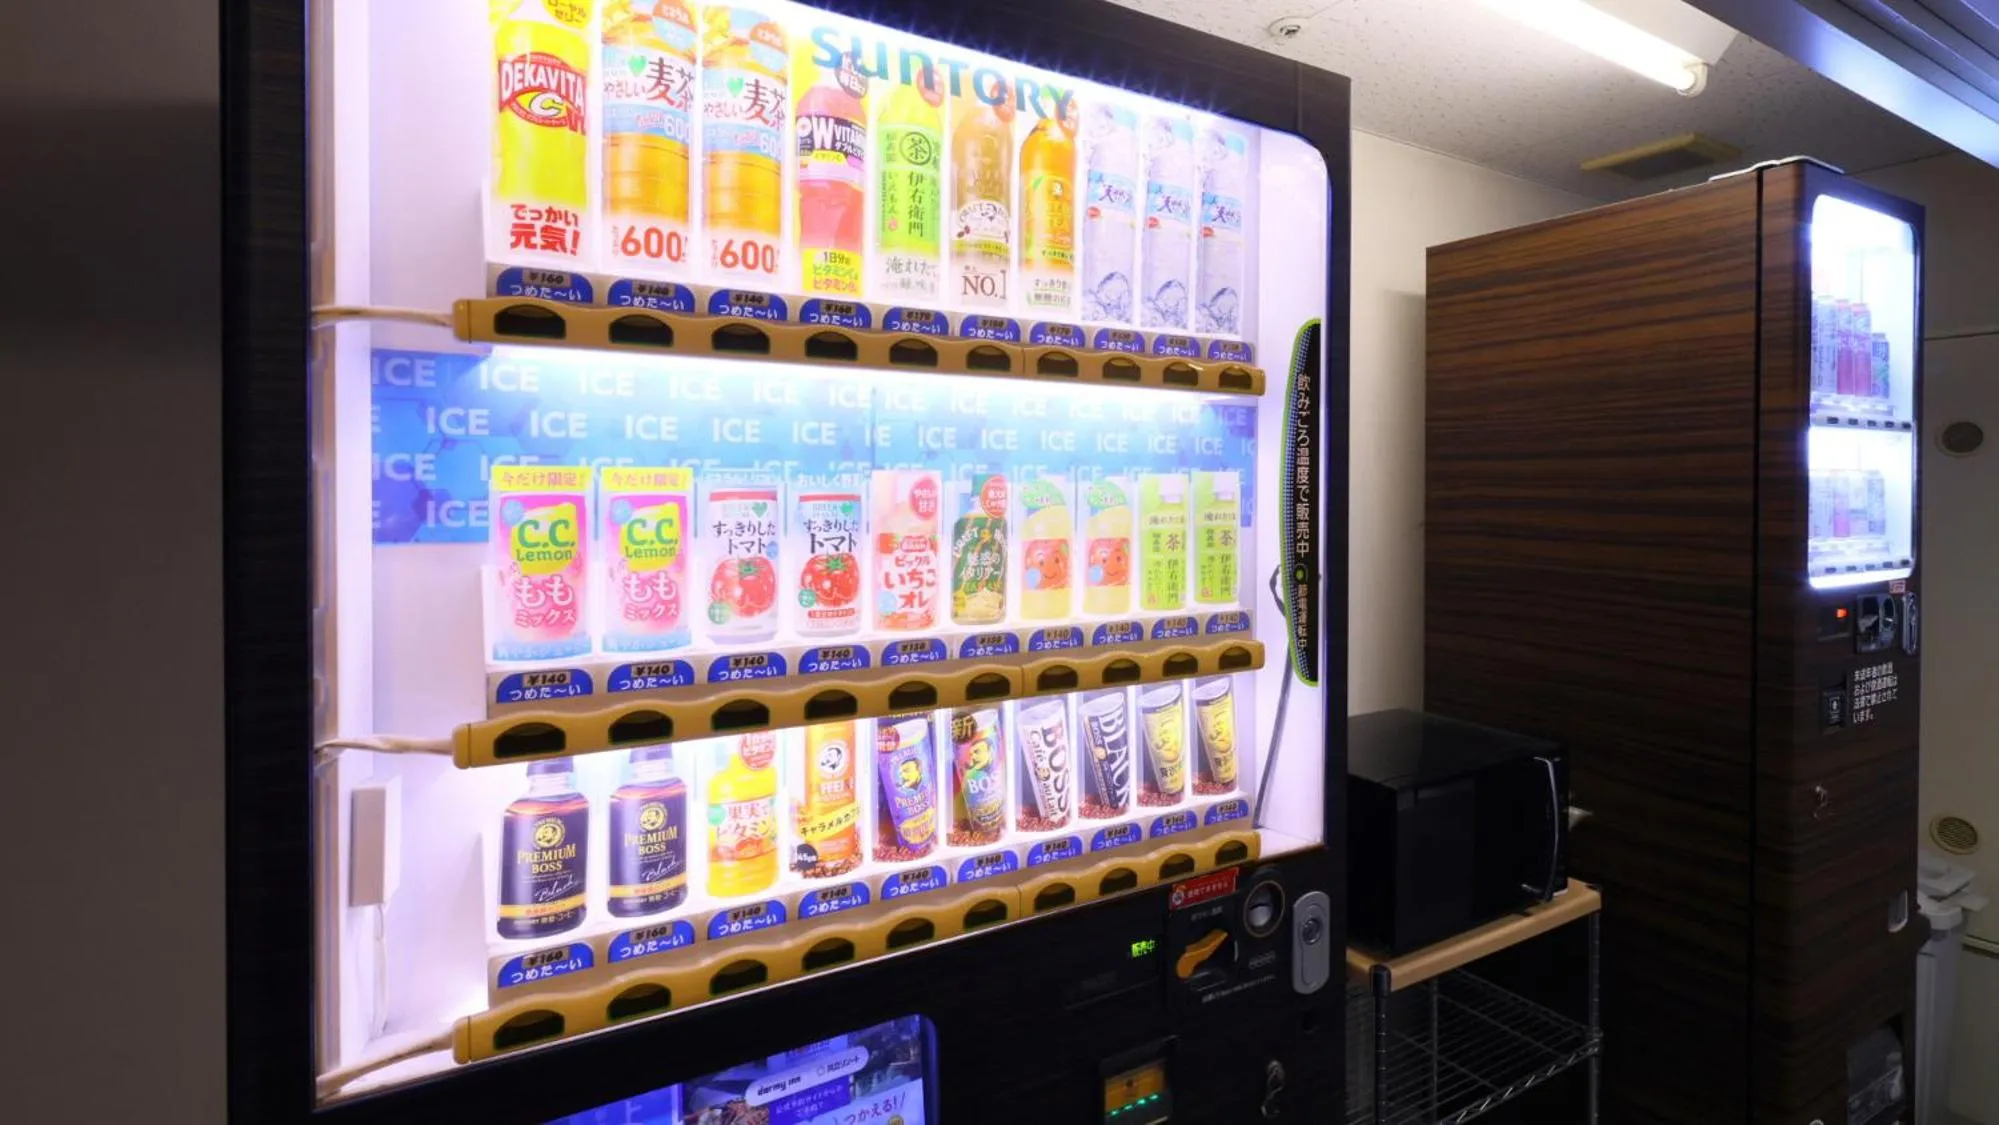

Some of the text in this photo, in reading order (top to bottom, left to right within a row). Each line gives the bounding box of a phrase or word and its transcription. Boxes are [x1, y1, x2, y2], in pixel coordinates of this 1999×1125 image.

[501, 61, 585, 117] DEKAVITA
[646, 57, 695, 112] 麦茶
[905, 134, 928, 161] 茶
[510, 204, 578, 226] でっかい
[908, 170, 925, 238] 伊右衛門
[510, 223, 580, 256] 元気!
[620, 225, 682, 262] 600
[719, 239, 775, 275] 600
[372, 357, 437, 388] ICE
[480, 363, 541, 392] ICE
[580, 369, 637, 397] ICE
[427, 406, 491, 436] ICE
[529, 410, 588, 439] ICE
[625, 415, 678, 441] ICE
[713, 417, 761, 443] ICE
[792, 421, 837, 445] ICE
[918, 425, 957, 448] ICE
[981, 430, 1018, 451] ICE
[1041, 430, 1075, 452] ICE
[1097, 433, 1128, 453] ICE
[1149, 435, 1178, 454] ICE
[1195, 436, 1223, 456] ICE
[372, 453, 436, 481] ICE
[1297, 373, 1311, 558] 飲みごろ温度で販売中
[427, 500, 489, 528] ICE
[518, 518, 576, 549] C.C.
[627, 517, 678, 547] C.C.
[713, 520, 776, 537] すっきりした
[803, 519, 859, 533] すっきりした
[727, 538, 767, 555] トマト
[810, 532, 857, 554] トマト
[1166, 534, 1180, 552] 茶
[1220, 530, 1234, 547] 茶
[516, 549, 573, 561] Lemon
[625, 545, 676, 559] Lemon
[624, 570, 678, 603] もも
[884, 568, 936, 589] いちご
[515, 573, 575, 608] もも
[898, 592, 929, 609] オレ
[515, 608, 577, 627] ミックス
[624, 602, 679, 621] ミックス
[733, 655, 765, 668] ¥140
[821, 648, 850, 660] ¥140
[527, 672, 566, 686] ¥140
[635, 664, 670, 677] ¥140
[953, 717, 977, 741] 新
[1041, 720, 1070, 813] BOSS
[624, 827, 678, 847] PREMIUM
[517, 844, 576, 864] PREMIUM
[638, 844, 667, 856] BOSS
[531, 861, 563, 874] BOSS
[635, 926, 667, 940] ¥160
[529, 950, 563, 966] ¥160
[758, 1080, 786, 1096] dormy
